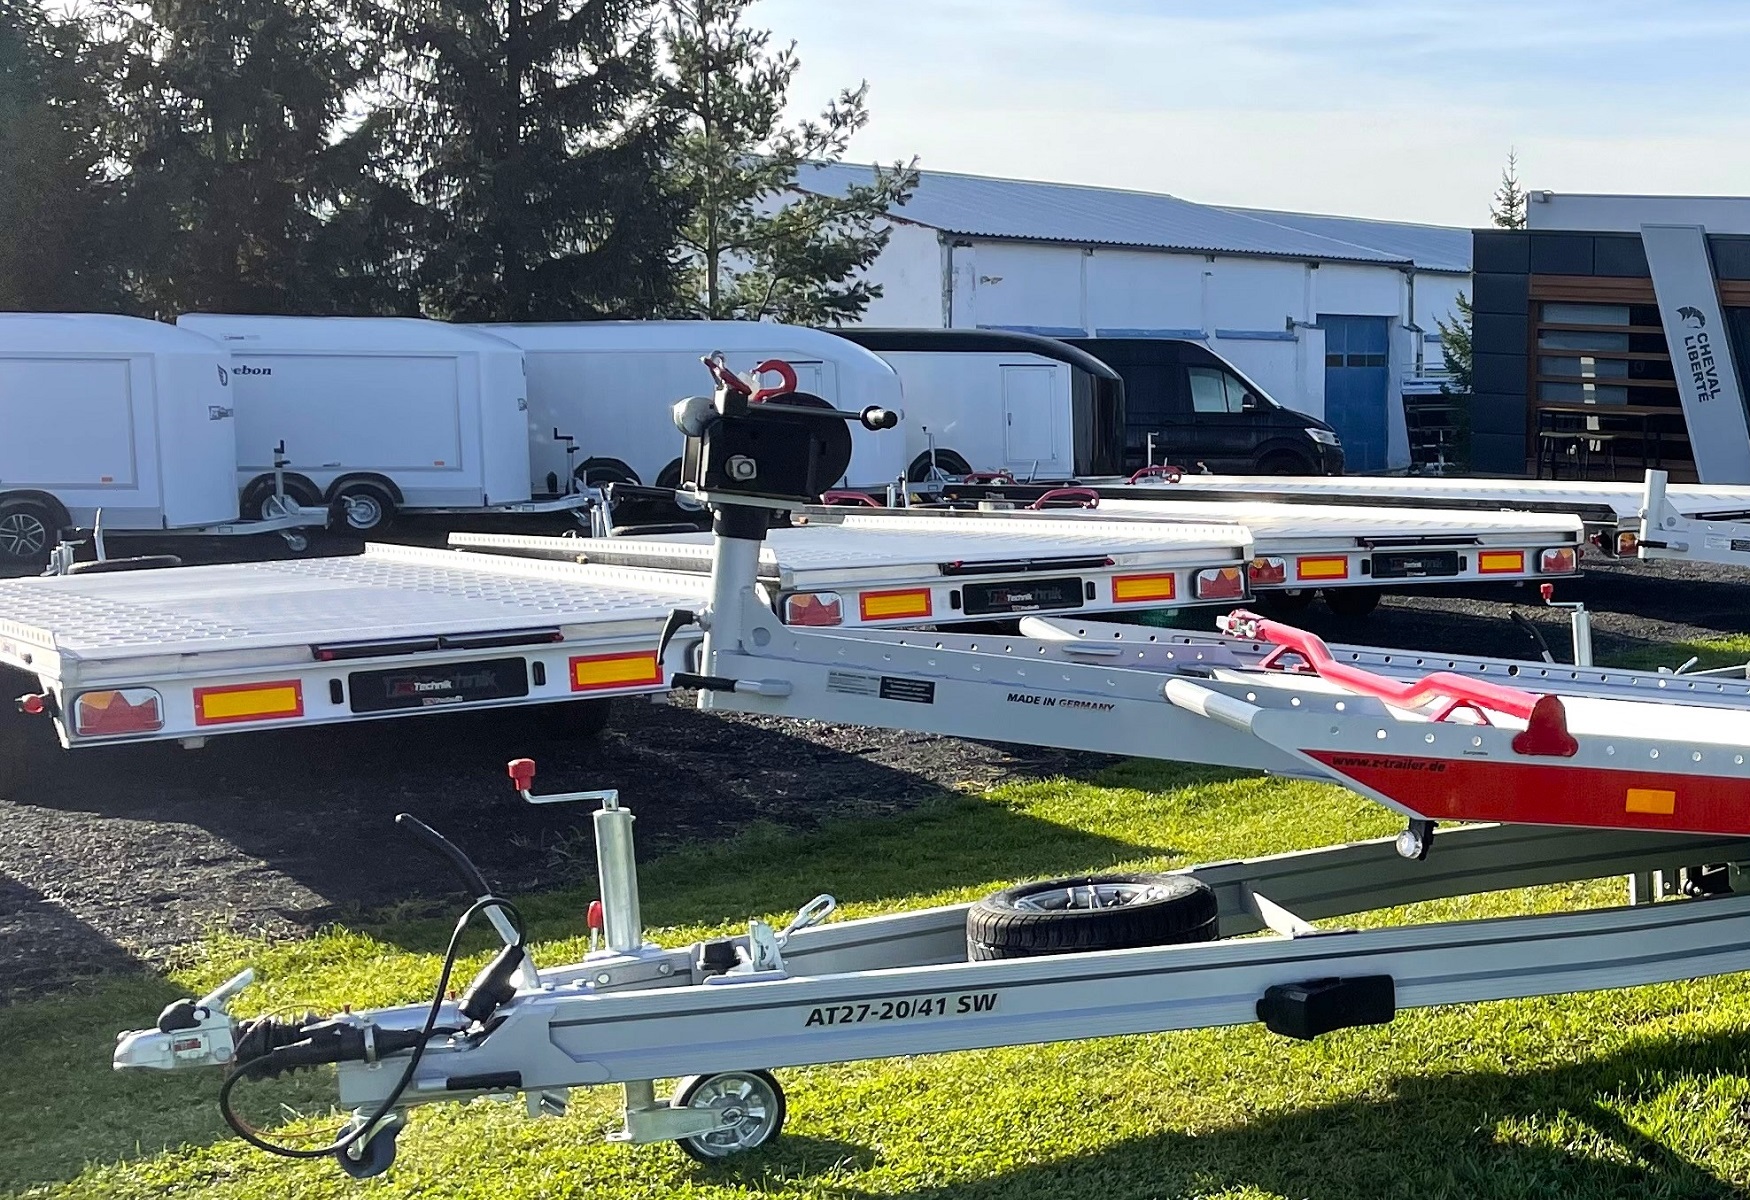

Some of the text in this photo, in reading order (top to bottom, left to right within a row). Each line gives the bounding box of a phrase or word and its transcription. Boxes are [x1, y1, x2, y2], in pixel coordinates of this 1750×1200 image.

[232, 364, 272, 376] ebon
[1697, 332, 1721, 400] CHEVAL
[1007, 693, 1116, 712] MADE IN GERMANY
[805, 993, 998, 1028] AT27-20/41 SW
